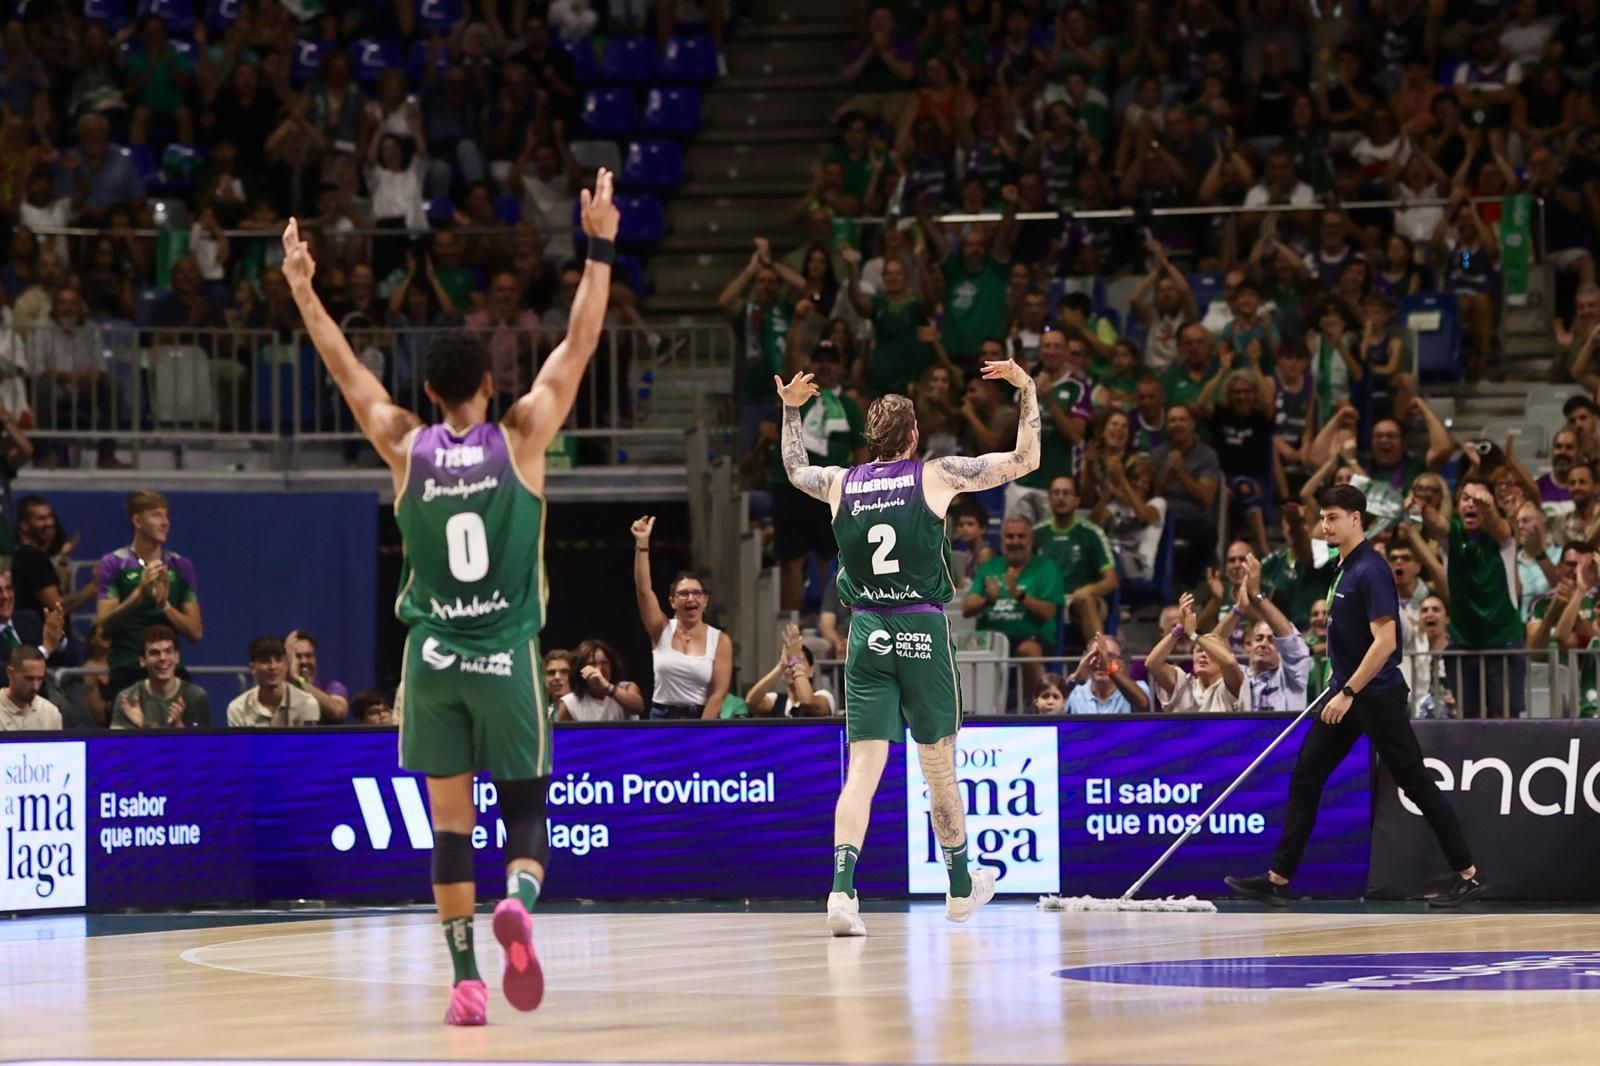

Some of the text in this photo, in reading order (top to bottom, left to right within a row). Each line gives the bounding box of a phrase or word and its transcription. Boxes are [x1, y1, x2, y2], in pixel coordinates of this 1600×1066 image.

[446, 512, 490, 582] 0
[867, 523, 900, 576] 2
[895, 641, 932, 652] DEL SOL
[896, 631, 932, 643] COSTA
[5, 753, 53, 785] sabor
[1397, 738, 1600, 816] end
[622, 772, 775, 804] Provincial
[1085, 778, 1202, 804] El sabor
[101, 791, 167, 818] El sabor
[101, 823, 200, 854] que nos une
[1085, 811, 1265, 841] que nos une
[924, 810, 1044, 882] lga
